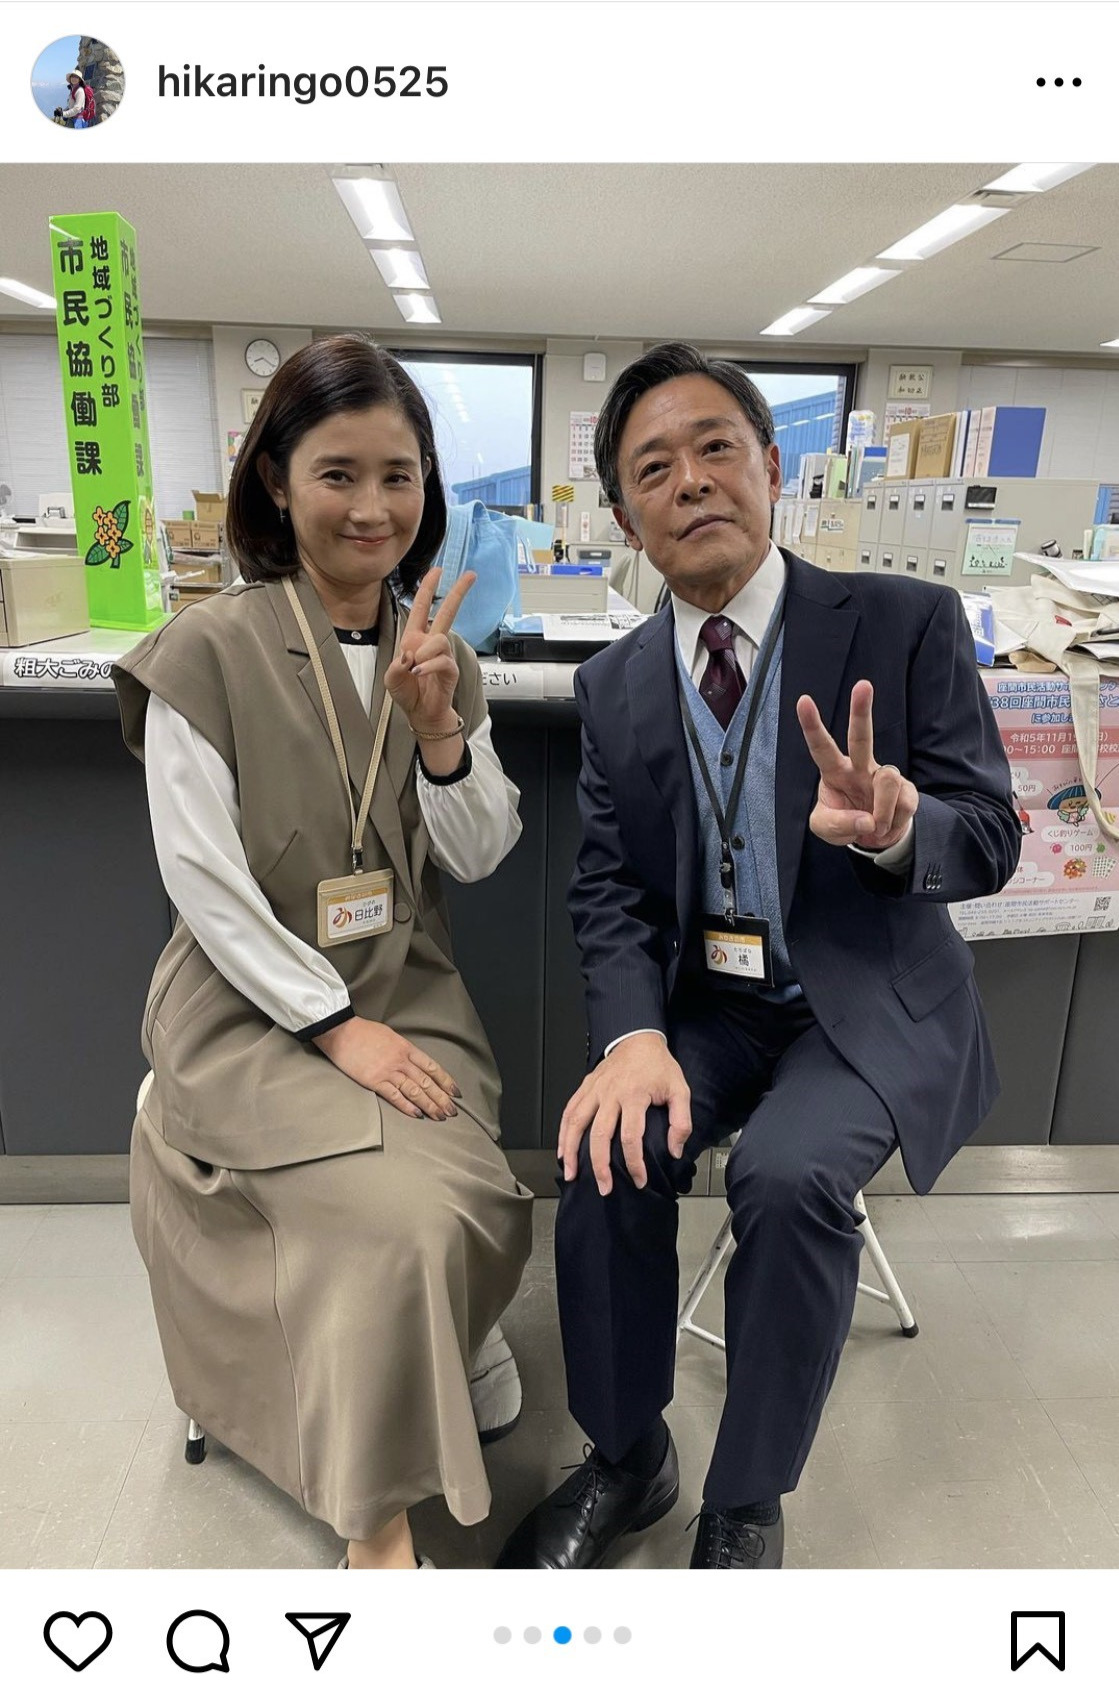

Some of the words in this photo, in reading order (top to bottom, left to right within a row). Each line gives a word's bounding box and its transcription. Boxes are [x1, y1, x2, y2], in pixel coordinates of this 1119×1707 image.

[89, 235, 121, 408] 地域づくり部
[57, 237, 103, 476] 市民協働課
[1017, 784, 1037, 793] 50円
[1047, 829, 1094, 839] くじ釣りゲーム
[1070, 844, 1093, 853] 100円
[354, 904, 383, 921] 日比野
